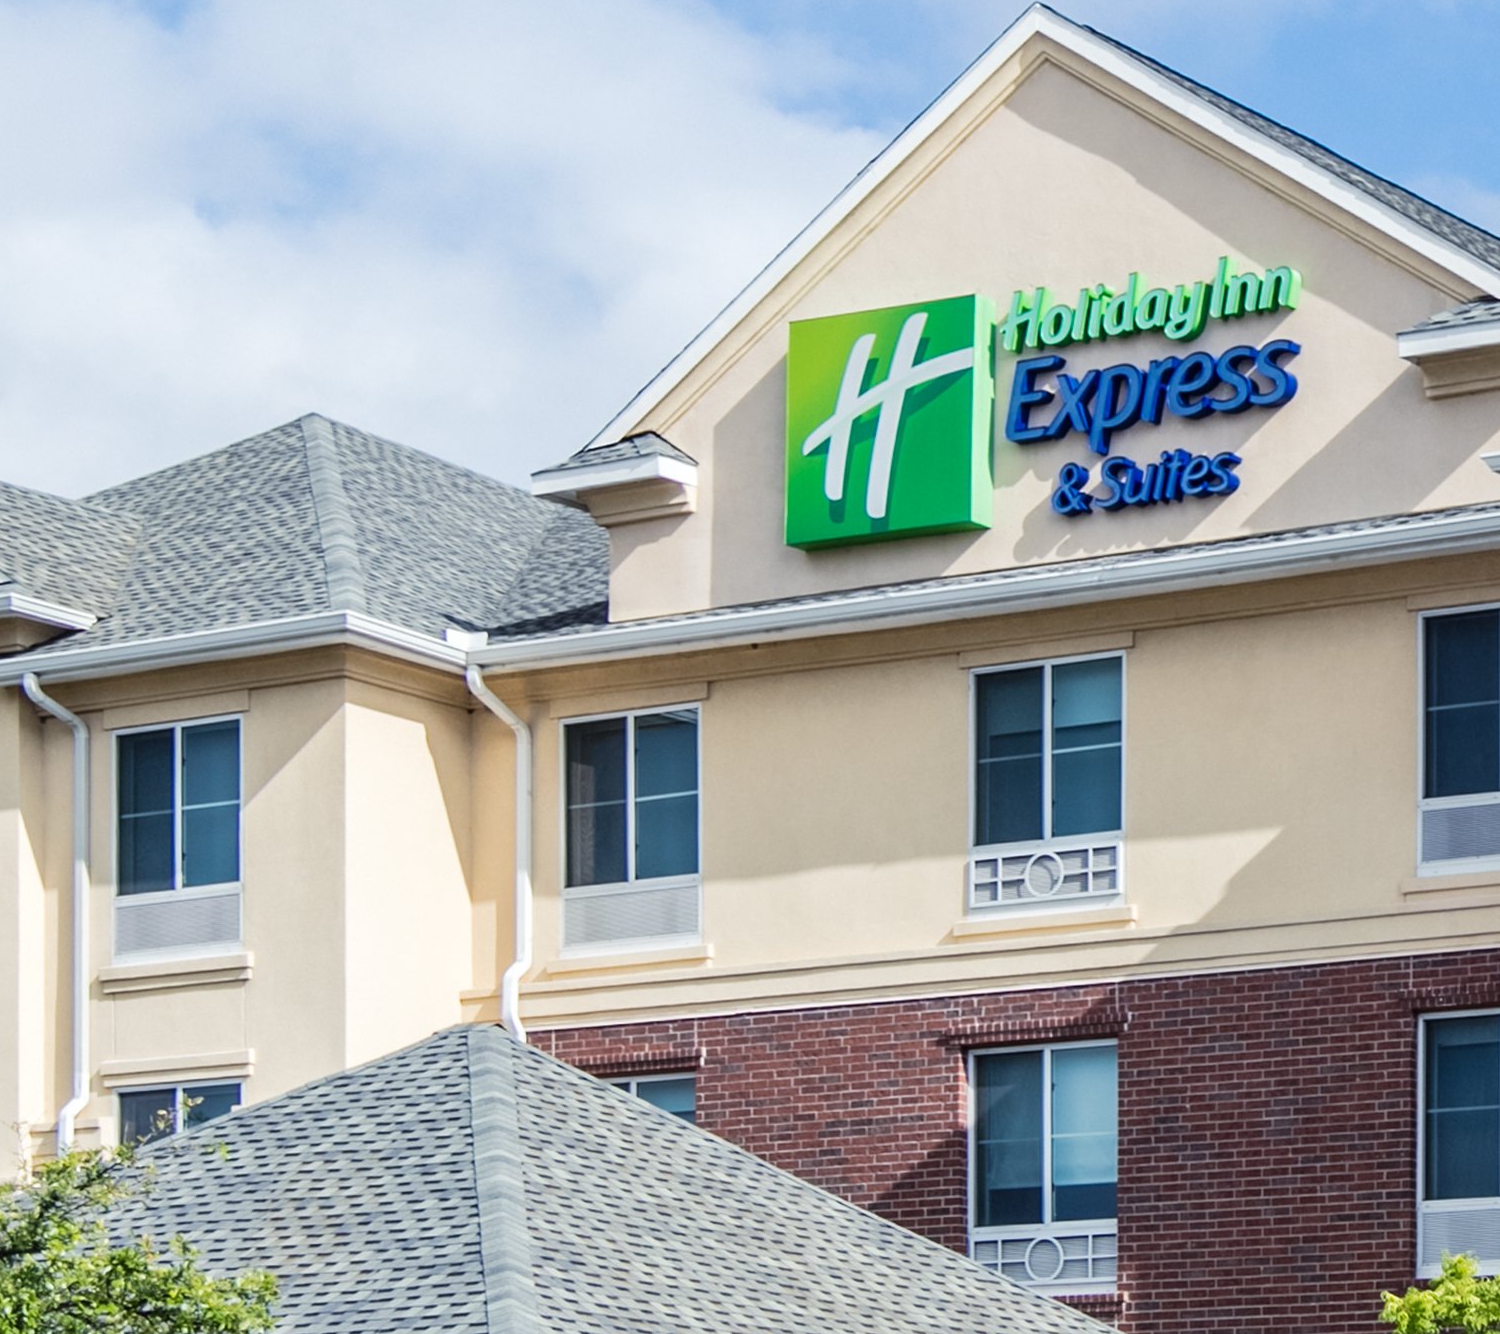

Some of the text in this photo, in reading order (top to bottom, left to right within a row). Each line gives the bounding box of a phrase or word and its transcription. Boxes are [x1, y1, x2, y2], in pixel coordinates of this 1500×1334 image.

[1001, 255, 1302, 353] Holiday Inn
[1005, 339, 1302, 456] Express
[1051, 448, 1242, 517] & Suites
